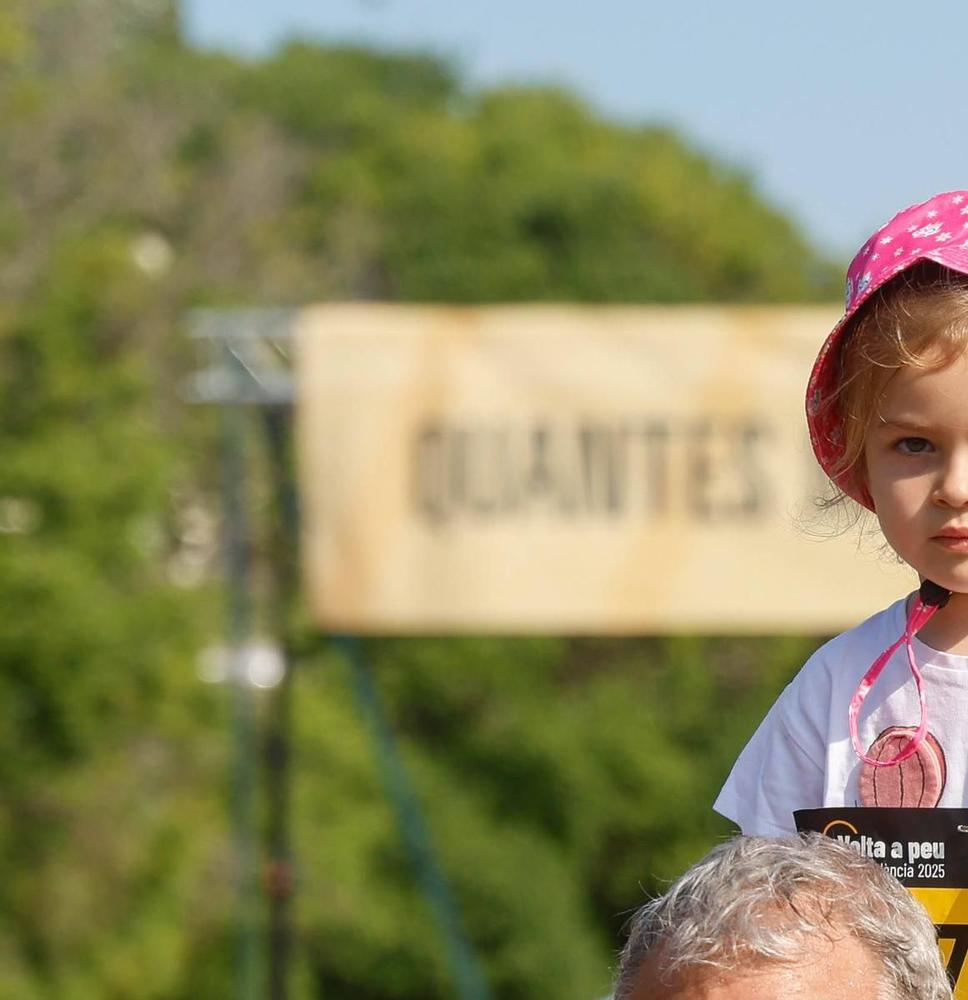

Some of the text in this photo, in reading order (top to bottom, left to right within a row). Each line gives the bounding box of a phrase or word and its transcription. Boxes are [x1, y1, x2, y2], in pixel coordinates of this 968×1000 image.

[412, 419, 772, 523] QUANTES
[890, 841, 904, 859] a
[908, 841, 945, 864] peu
[917, 863, 945, 878] 2025
